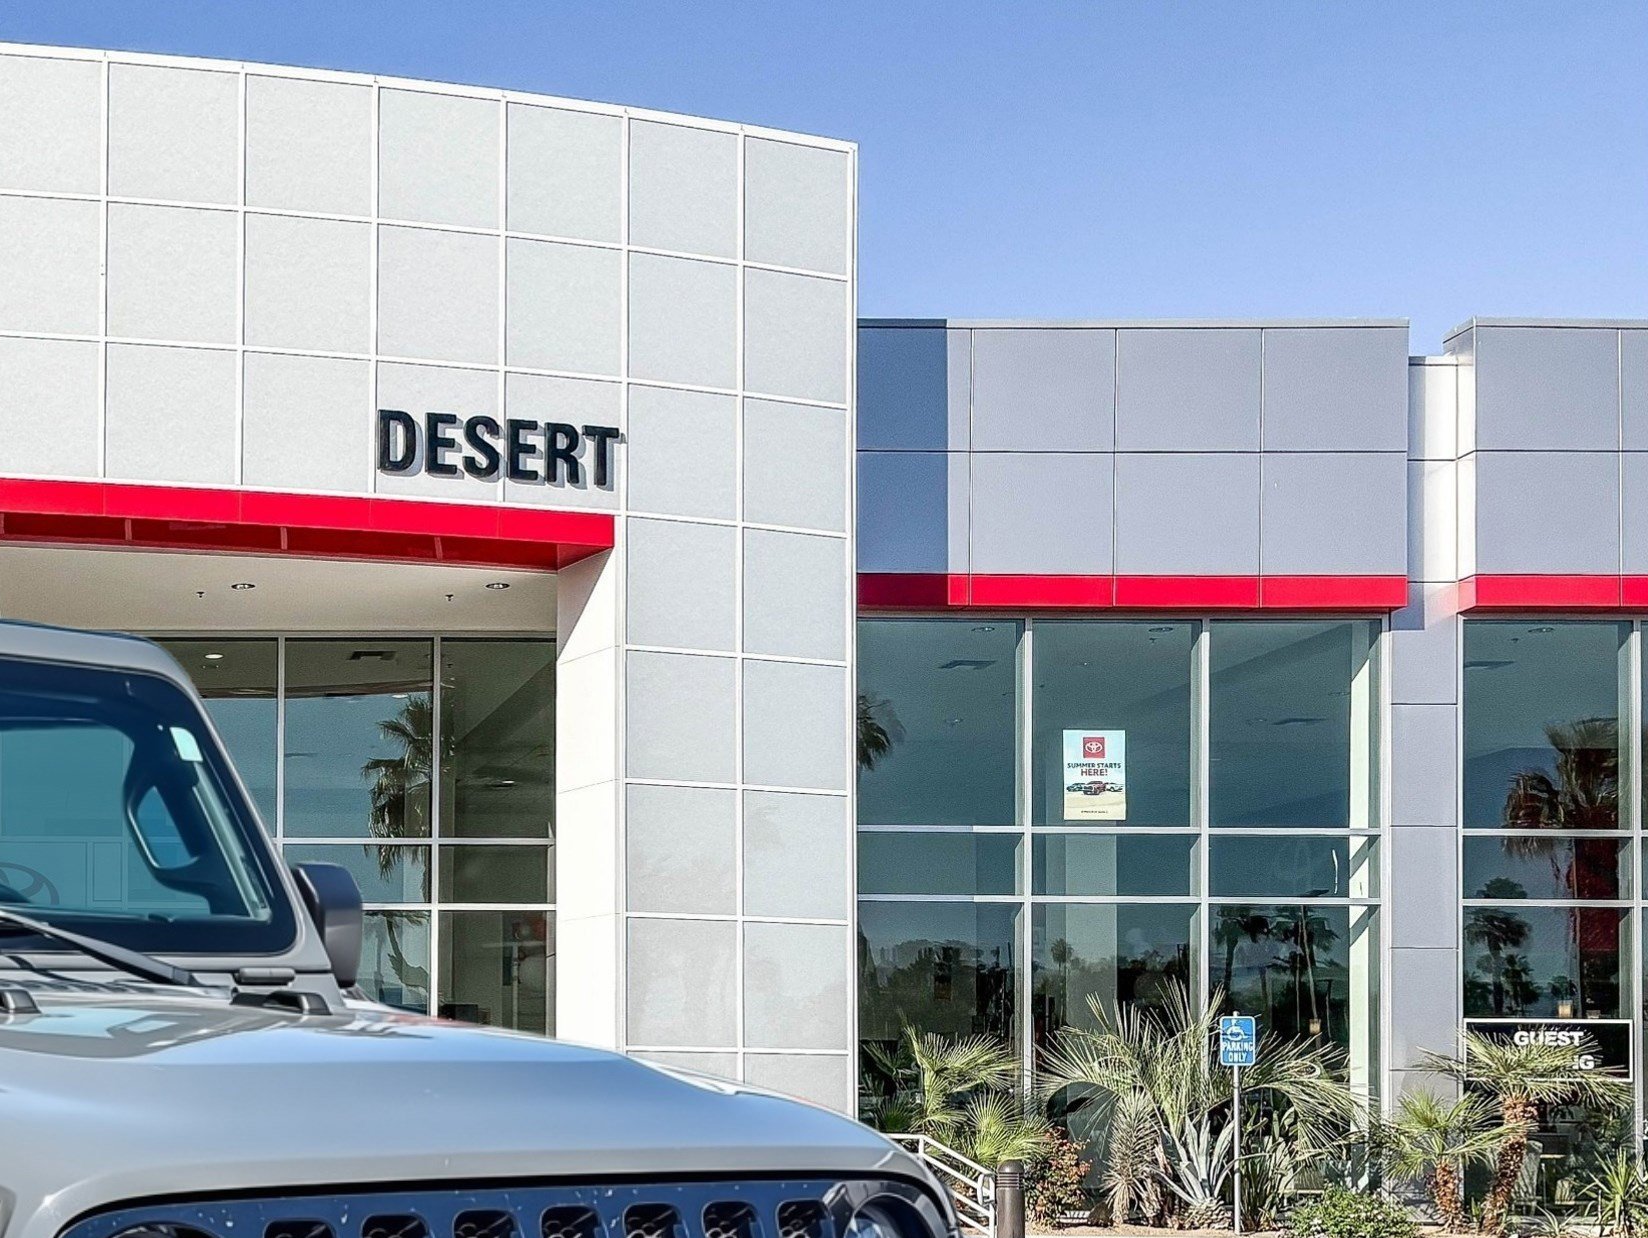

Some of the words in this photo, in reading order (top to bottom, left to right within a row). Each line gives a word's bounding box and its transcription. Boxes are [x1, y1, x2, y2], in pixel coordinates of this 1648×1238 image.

[377, 410, 620, 487] DESERT
[1513, 1030, 1584, 1046] GUEST
[1222, 1041, 1254, 1052] PARKING
[1228, 1051, 1248, 1062] ONLY
